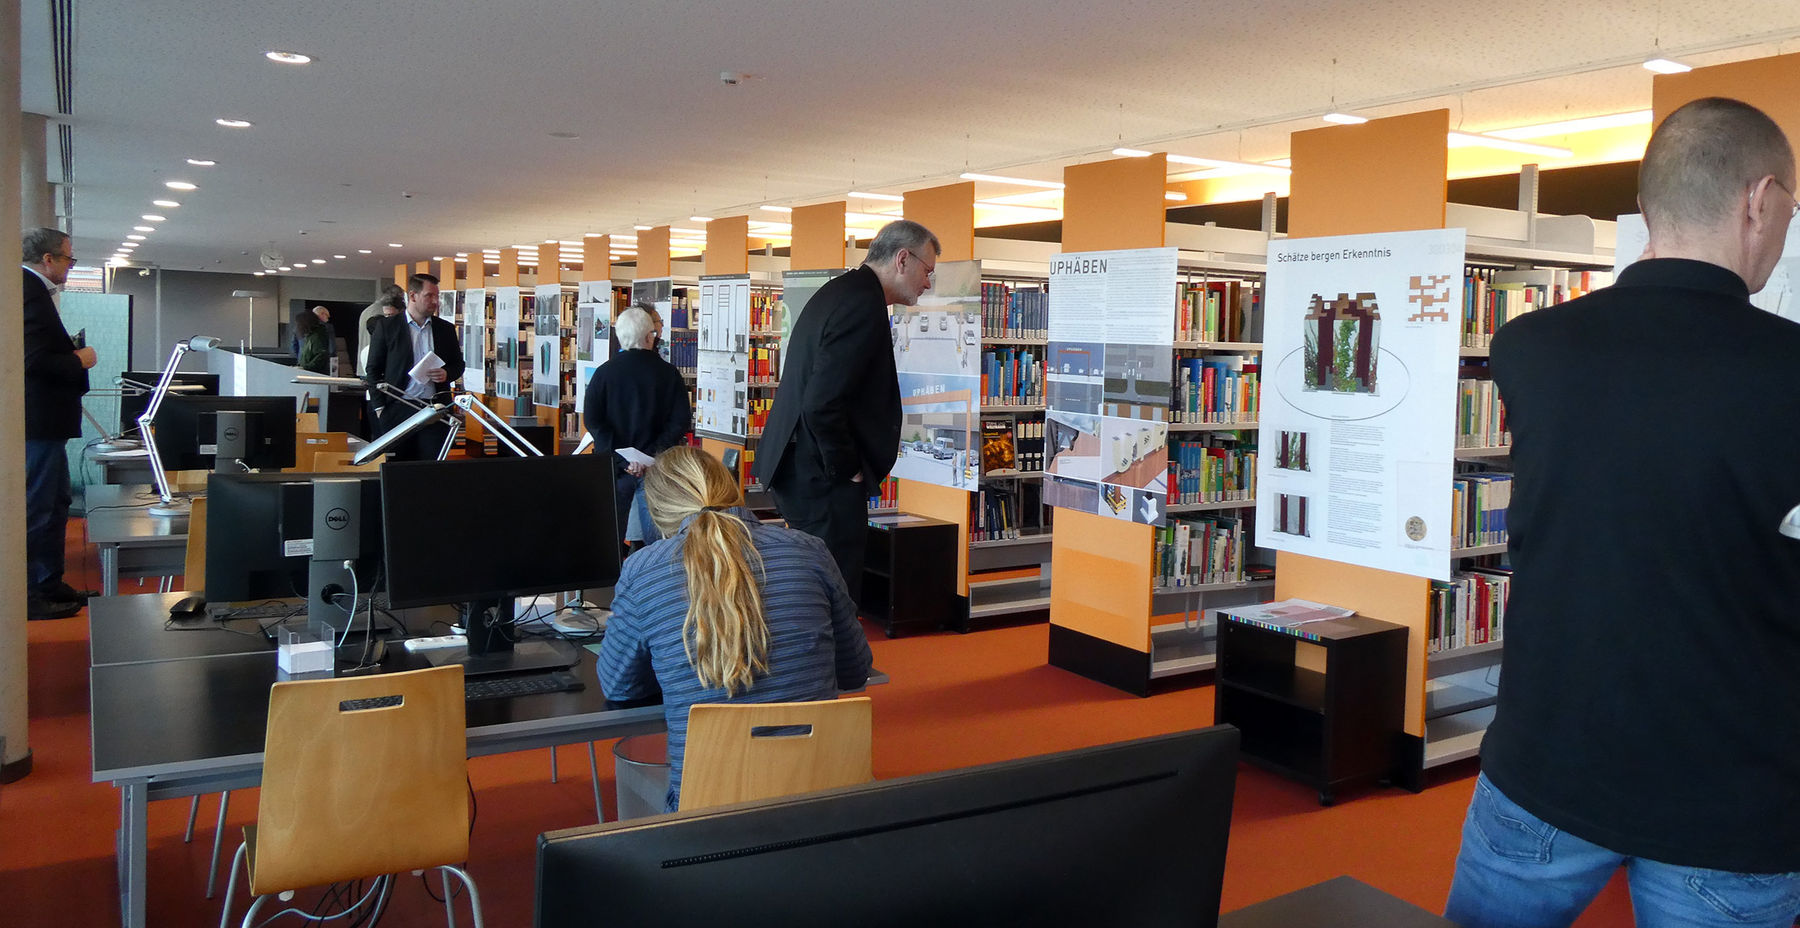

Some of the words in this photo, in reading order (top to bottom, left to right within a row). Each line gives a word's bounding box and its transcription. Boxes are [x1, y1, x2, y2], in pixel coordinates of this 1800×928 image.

[1277, 252, 1309, 262] Schätze
[1311, 251, 1340, 262] bergen
[1343, 247, 1391, 259] Erkenntnis
[1050, 256, 1107, 275] UPHÄBEN
